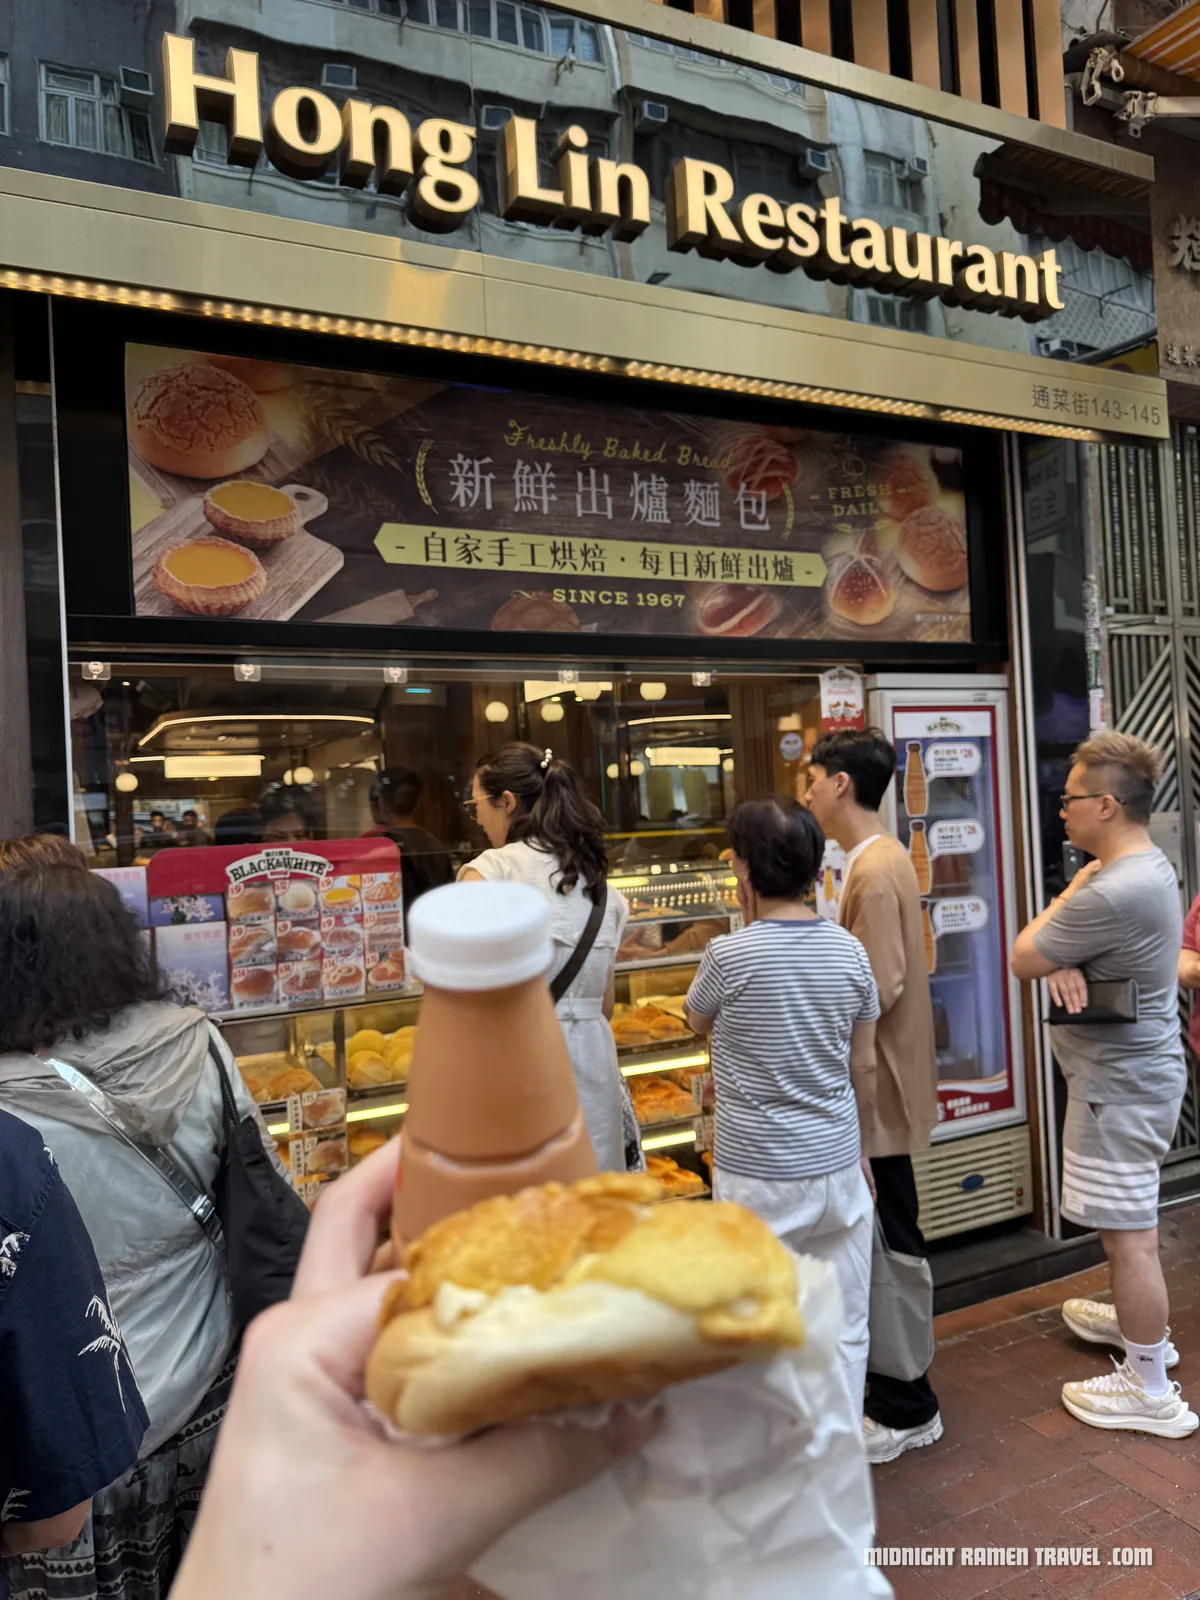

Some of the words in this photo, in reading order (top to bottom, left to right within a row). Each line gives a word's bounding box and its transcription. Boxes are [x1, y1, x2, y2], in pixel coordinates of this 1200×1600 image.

[162, 31, 480, 213] Hong
[506, 115, 650, 225] Lin
[677, 156, 1065, 311] Restaurant
[1032, 384, 1160, 426] 通菜街143-145
[504, 420, 591, 460] Freshly
[603, 437, 668, 463] Baked
[677, 445, 732, 469] Bread
[448, 452, 771, 531] 新鮮出爐麵包
[827, 484, 892, 500] FRESH
[553, 588, 629, 606] SINCE
[636, 592, 685, 607] 1967
